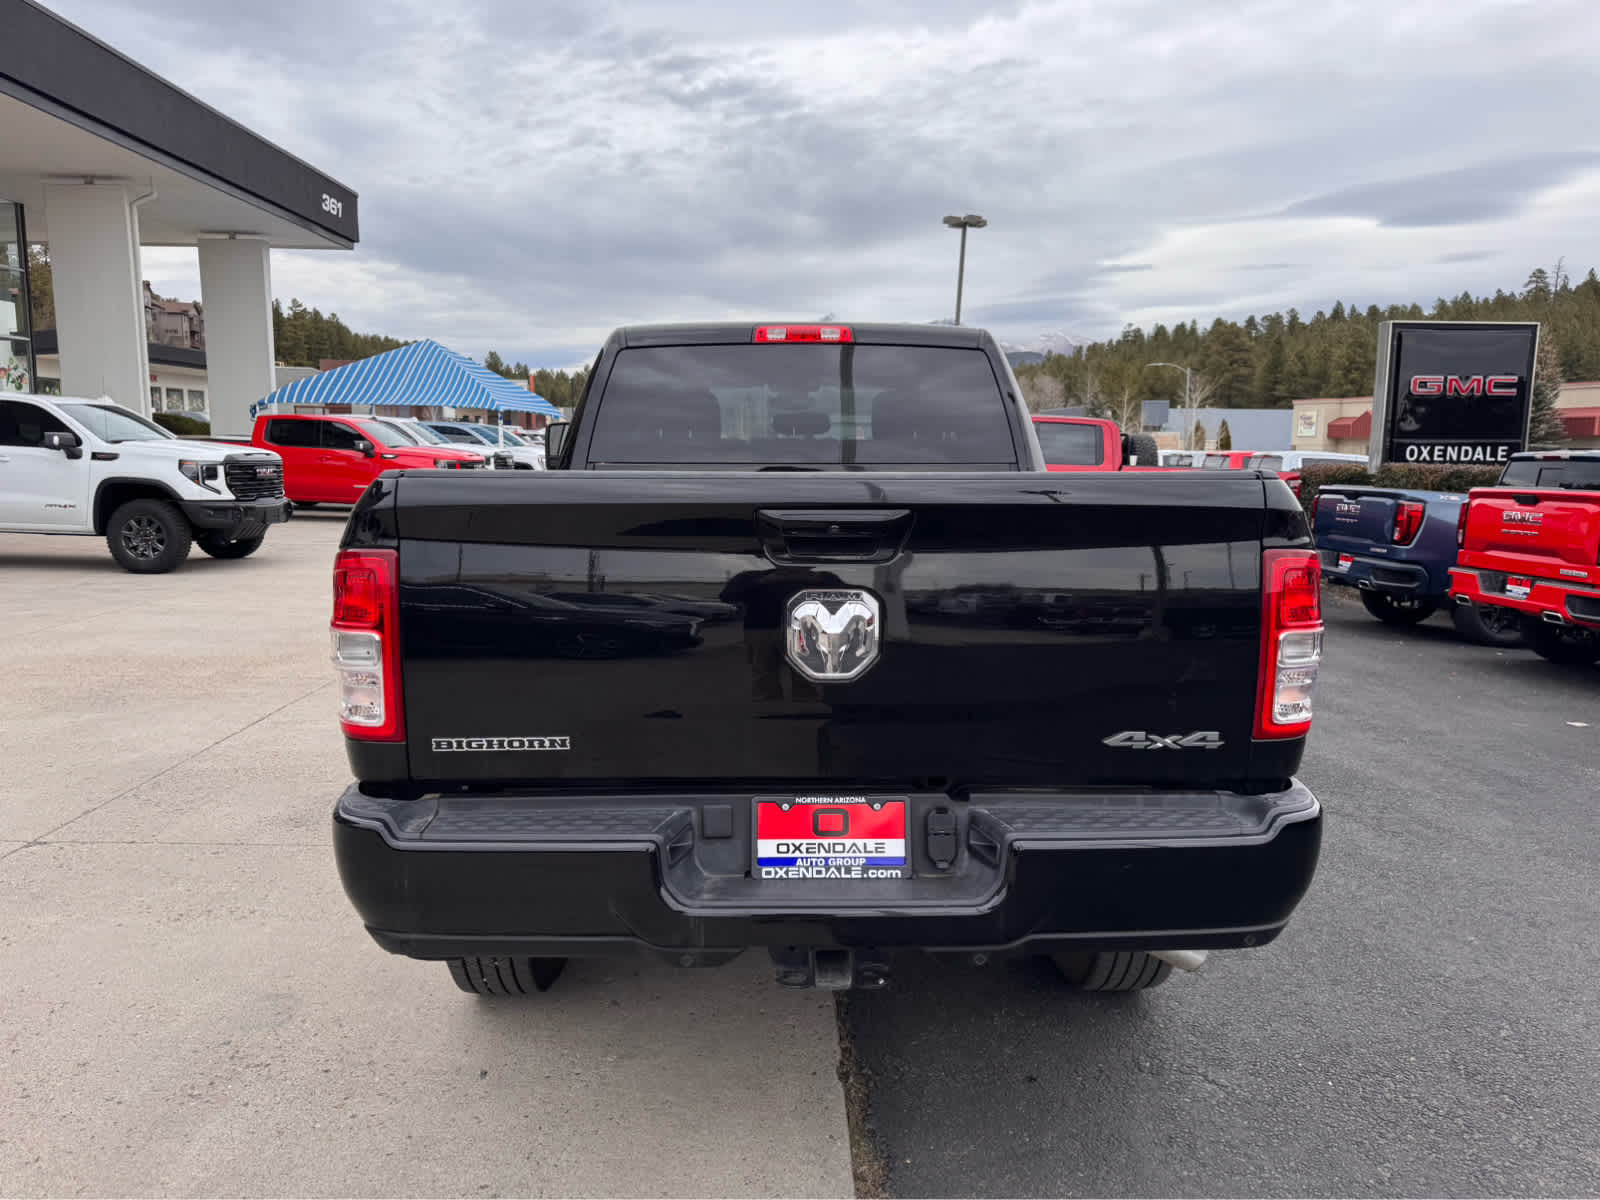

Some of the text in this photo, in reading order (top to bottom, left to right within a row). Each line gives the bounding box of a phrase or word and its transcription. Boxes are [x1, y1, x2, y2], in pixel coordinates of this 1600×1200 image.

[321, 192, 342, 218] 361
[1410, 375, 1518, 396] GMC
[1405, 444, 1509, 461] OXENDALE
[432, 736, 570, 751] BIGHORN
[795, 796, 866, 804] NORTHERN ARIZONA
[776, 842, 886, 854] OXENDALE
[795, 858, 866, 866] AUTO GROUP
[761, 866, 902, 879] OXENDALE.com
